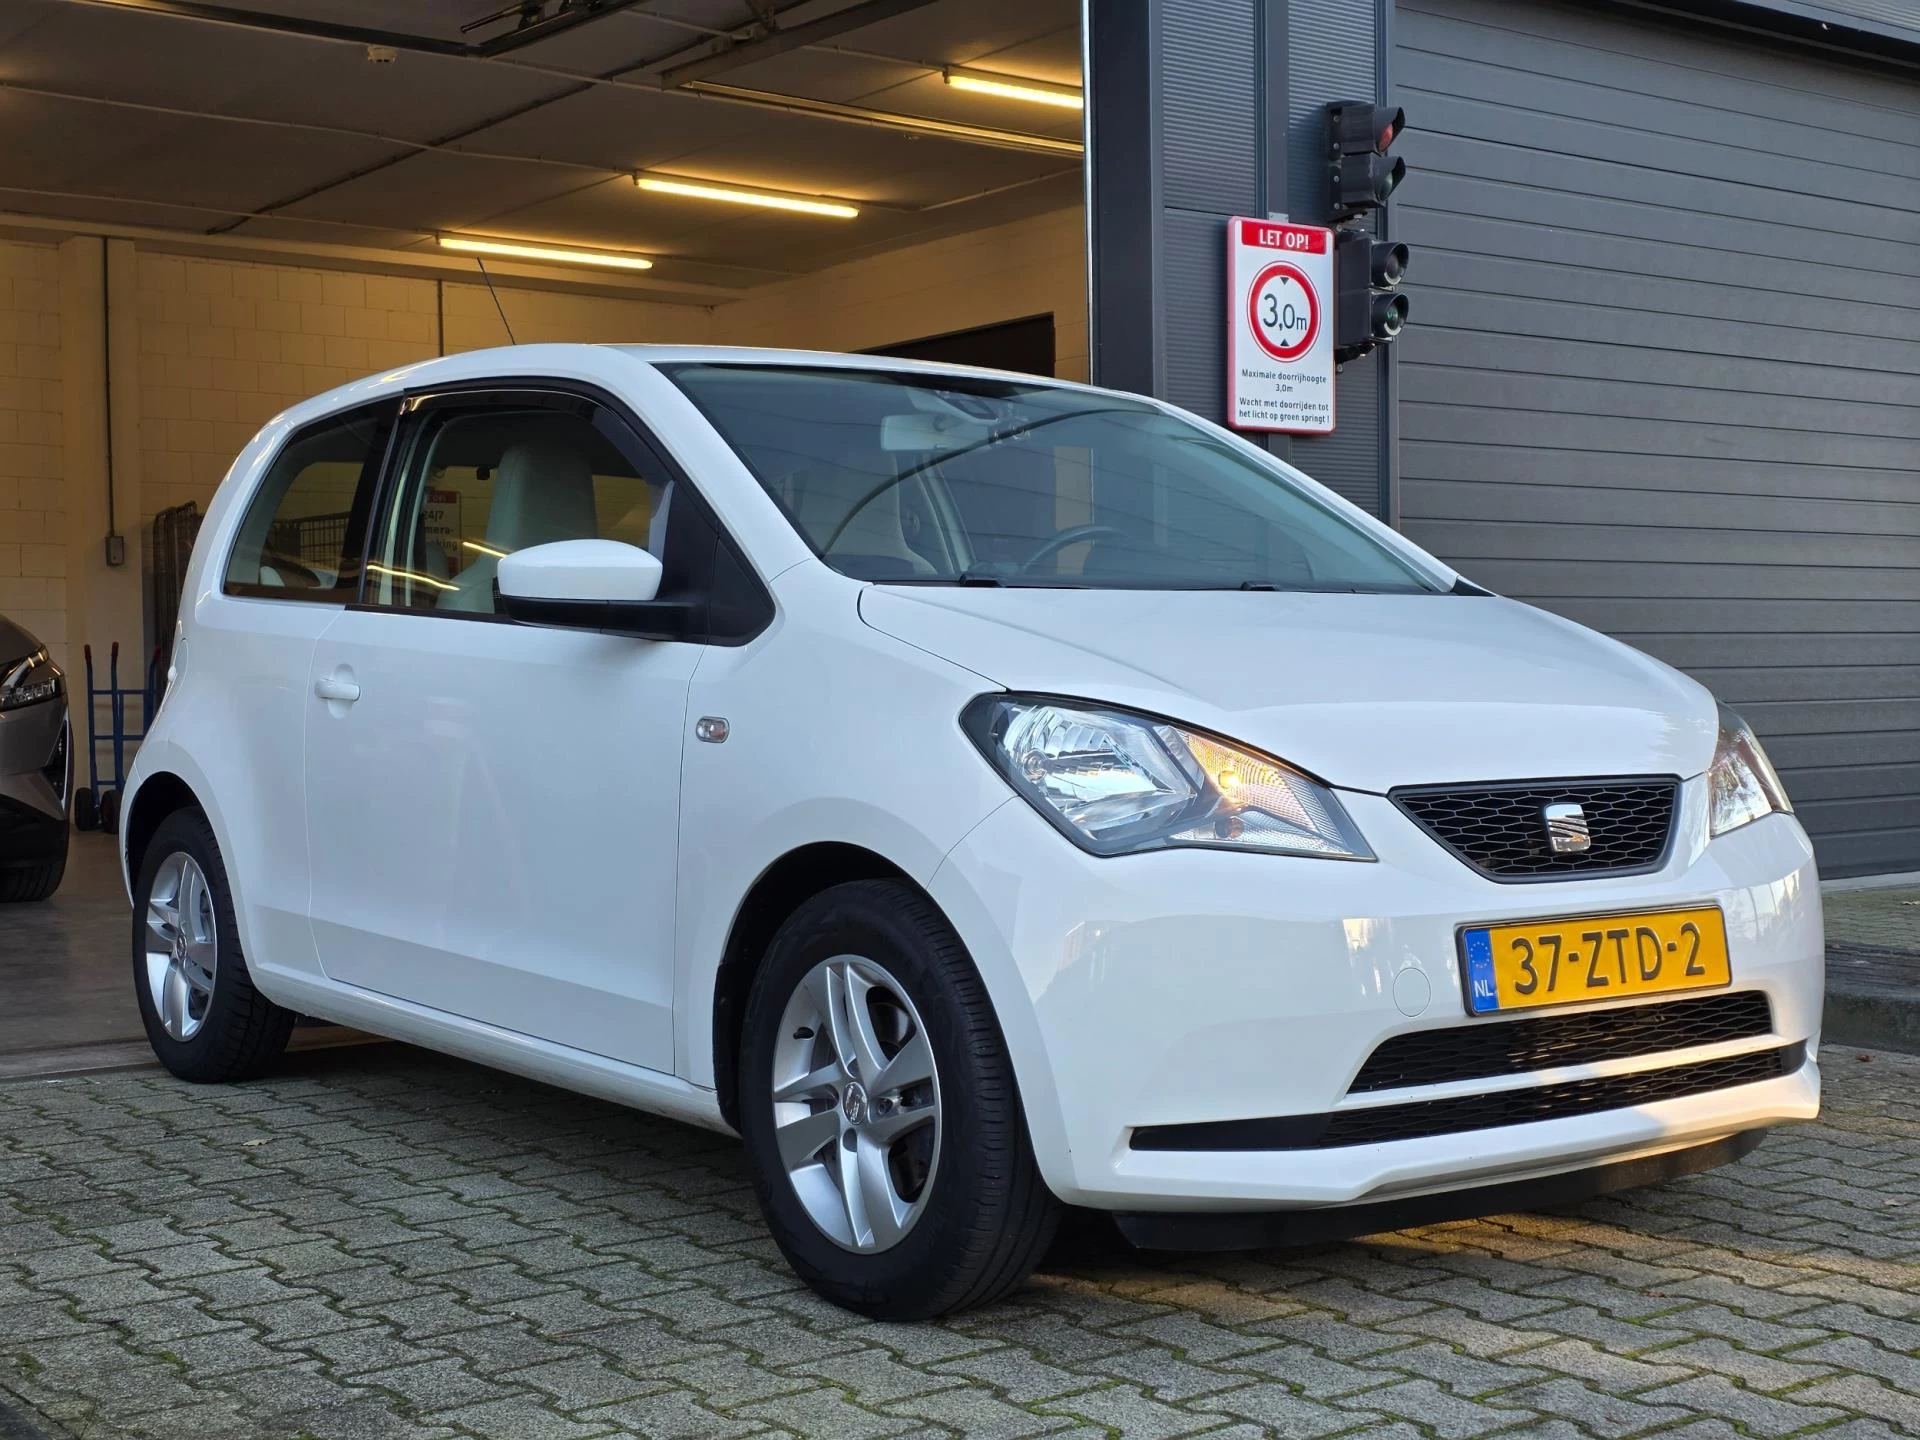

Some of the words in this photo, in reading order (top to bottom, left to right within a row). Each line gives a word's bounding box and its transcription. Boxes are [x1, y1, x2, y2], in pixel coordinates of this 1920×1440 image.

[1260, 228, 1282, 246] LET
[1285, 232, 1309, 250] OP!
[1263, 293, 1307, 331] 3,0m
[1242, 369, 1276, 380] Maximale
[1278, 372, 1327, 384] doorrijhoogte
[1275, 384, 1293, 393] 3,0m
[1240, 397, 1262, 406] Wacht
[1264, 399, 1277, 408] met
[1280, 400, 1316, 411] doorrijden
[1318, 403, 1329, 411] tot
[1239, 409, 1250, 418] het
[1252, 410, 1268, 419] licht
[1269, 412, 1278, 421] op
[1280, 413, 1299, 422] groen
[1301, 414, 1326, 424] springt
[1511, 922, 1706, 995] 37-ZTD-2
[1474, 979, 1494, 998] NL
